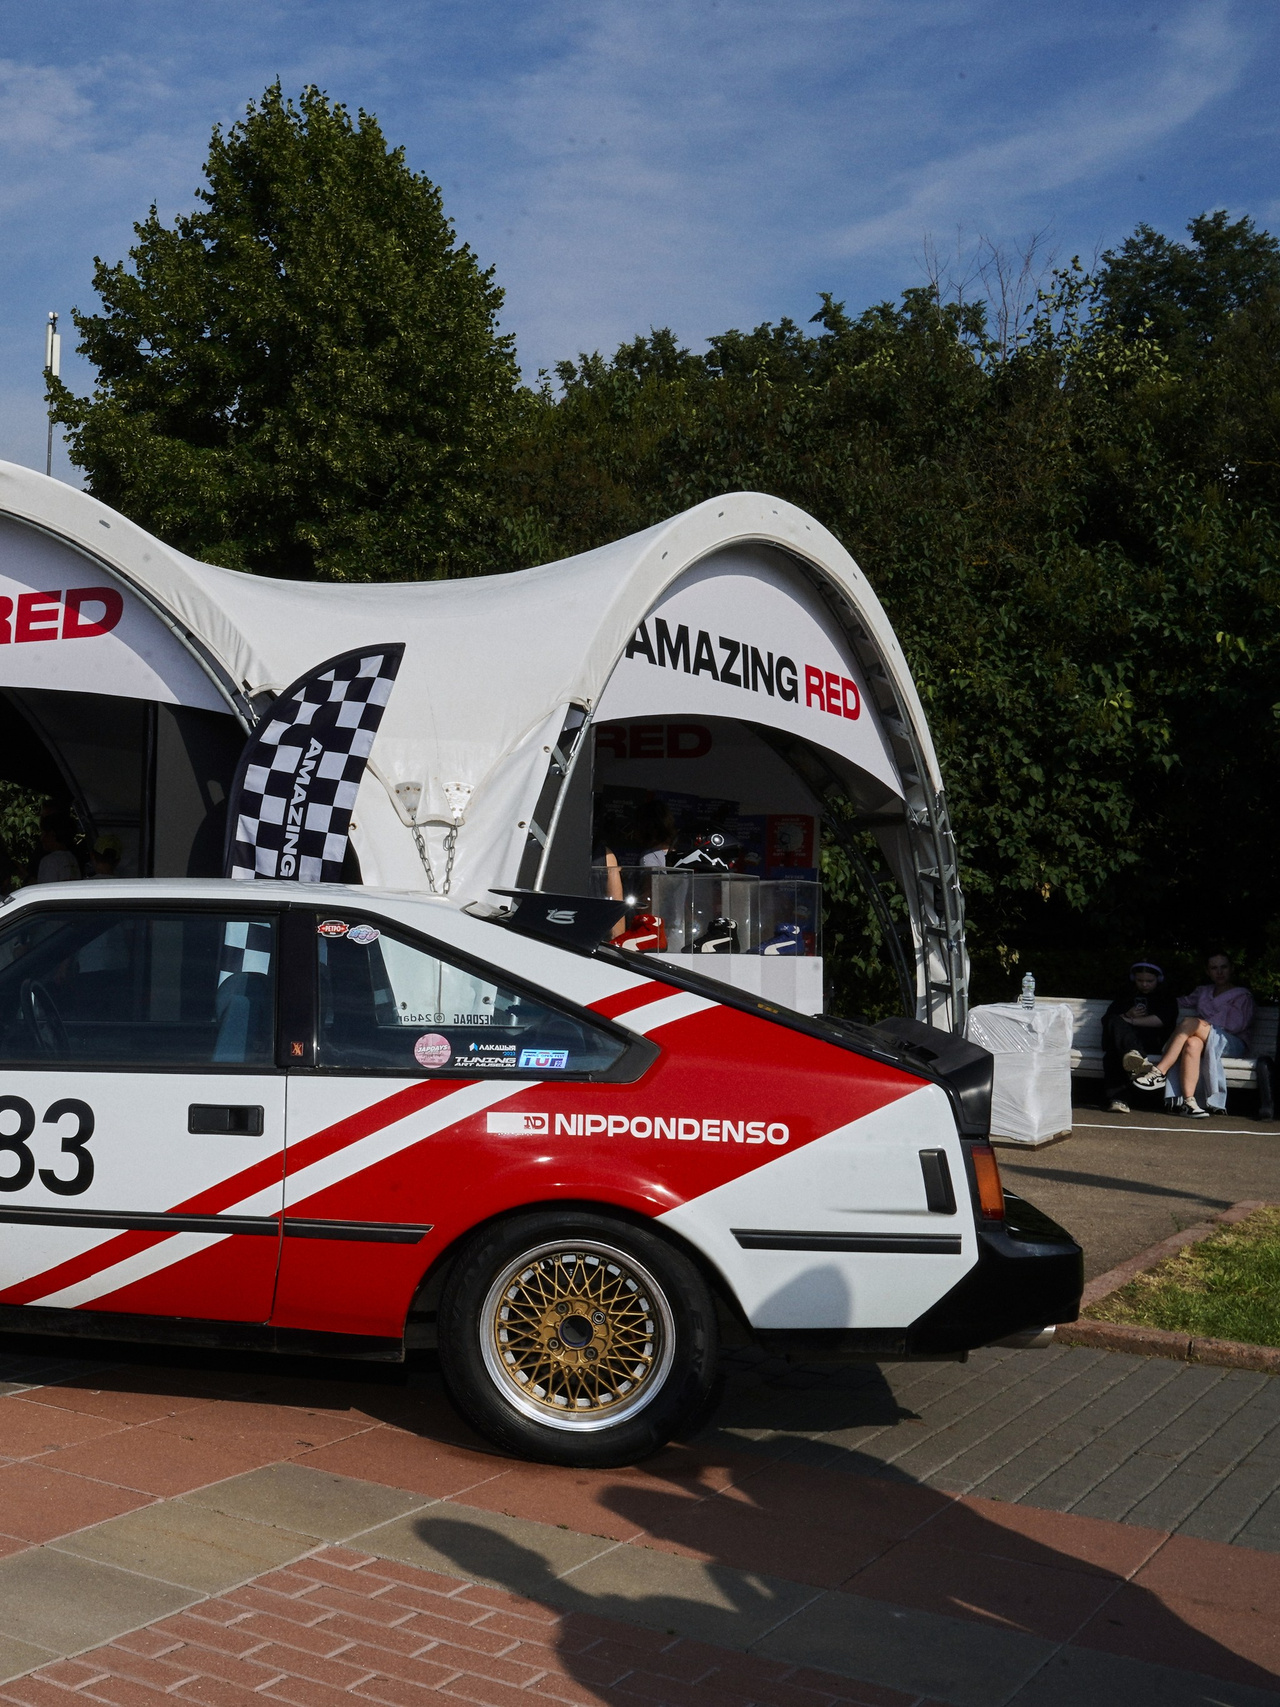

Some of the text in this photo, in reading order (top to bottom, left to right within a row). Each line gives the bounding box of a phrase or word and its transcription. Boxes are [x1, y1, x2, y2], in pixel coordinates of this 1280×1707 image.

[625, 617, 861, 721] AMAZING RED
[596, 724, 712, 759] RED
[280, 737, 323, 877] AMAZING
[555, 1113, 790, 1145] NIPPONDENSO
